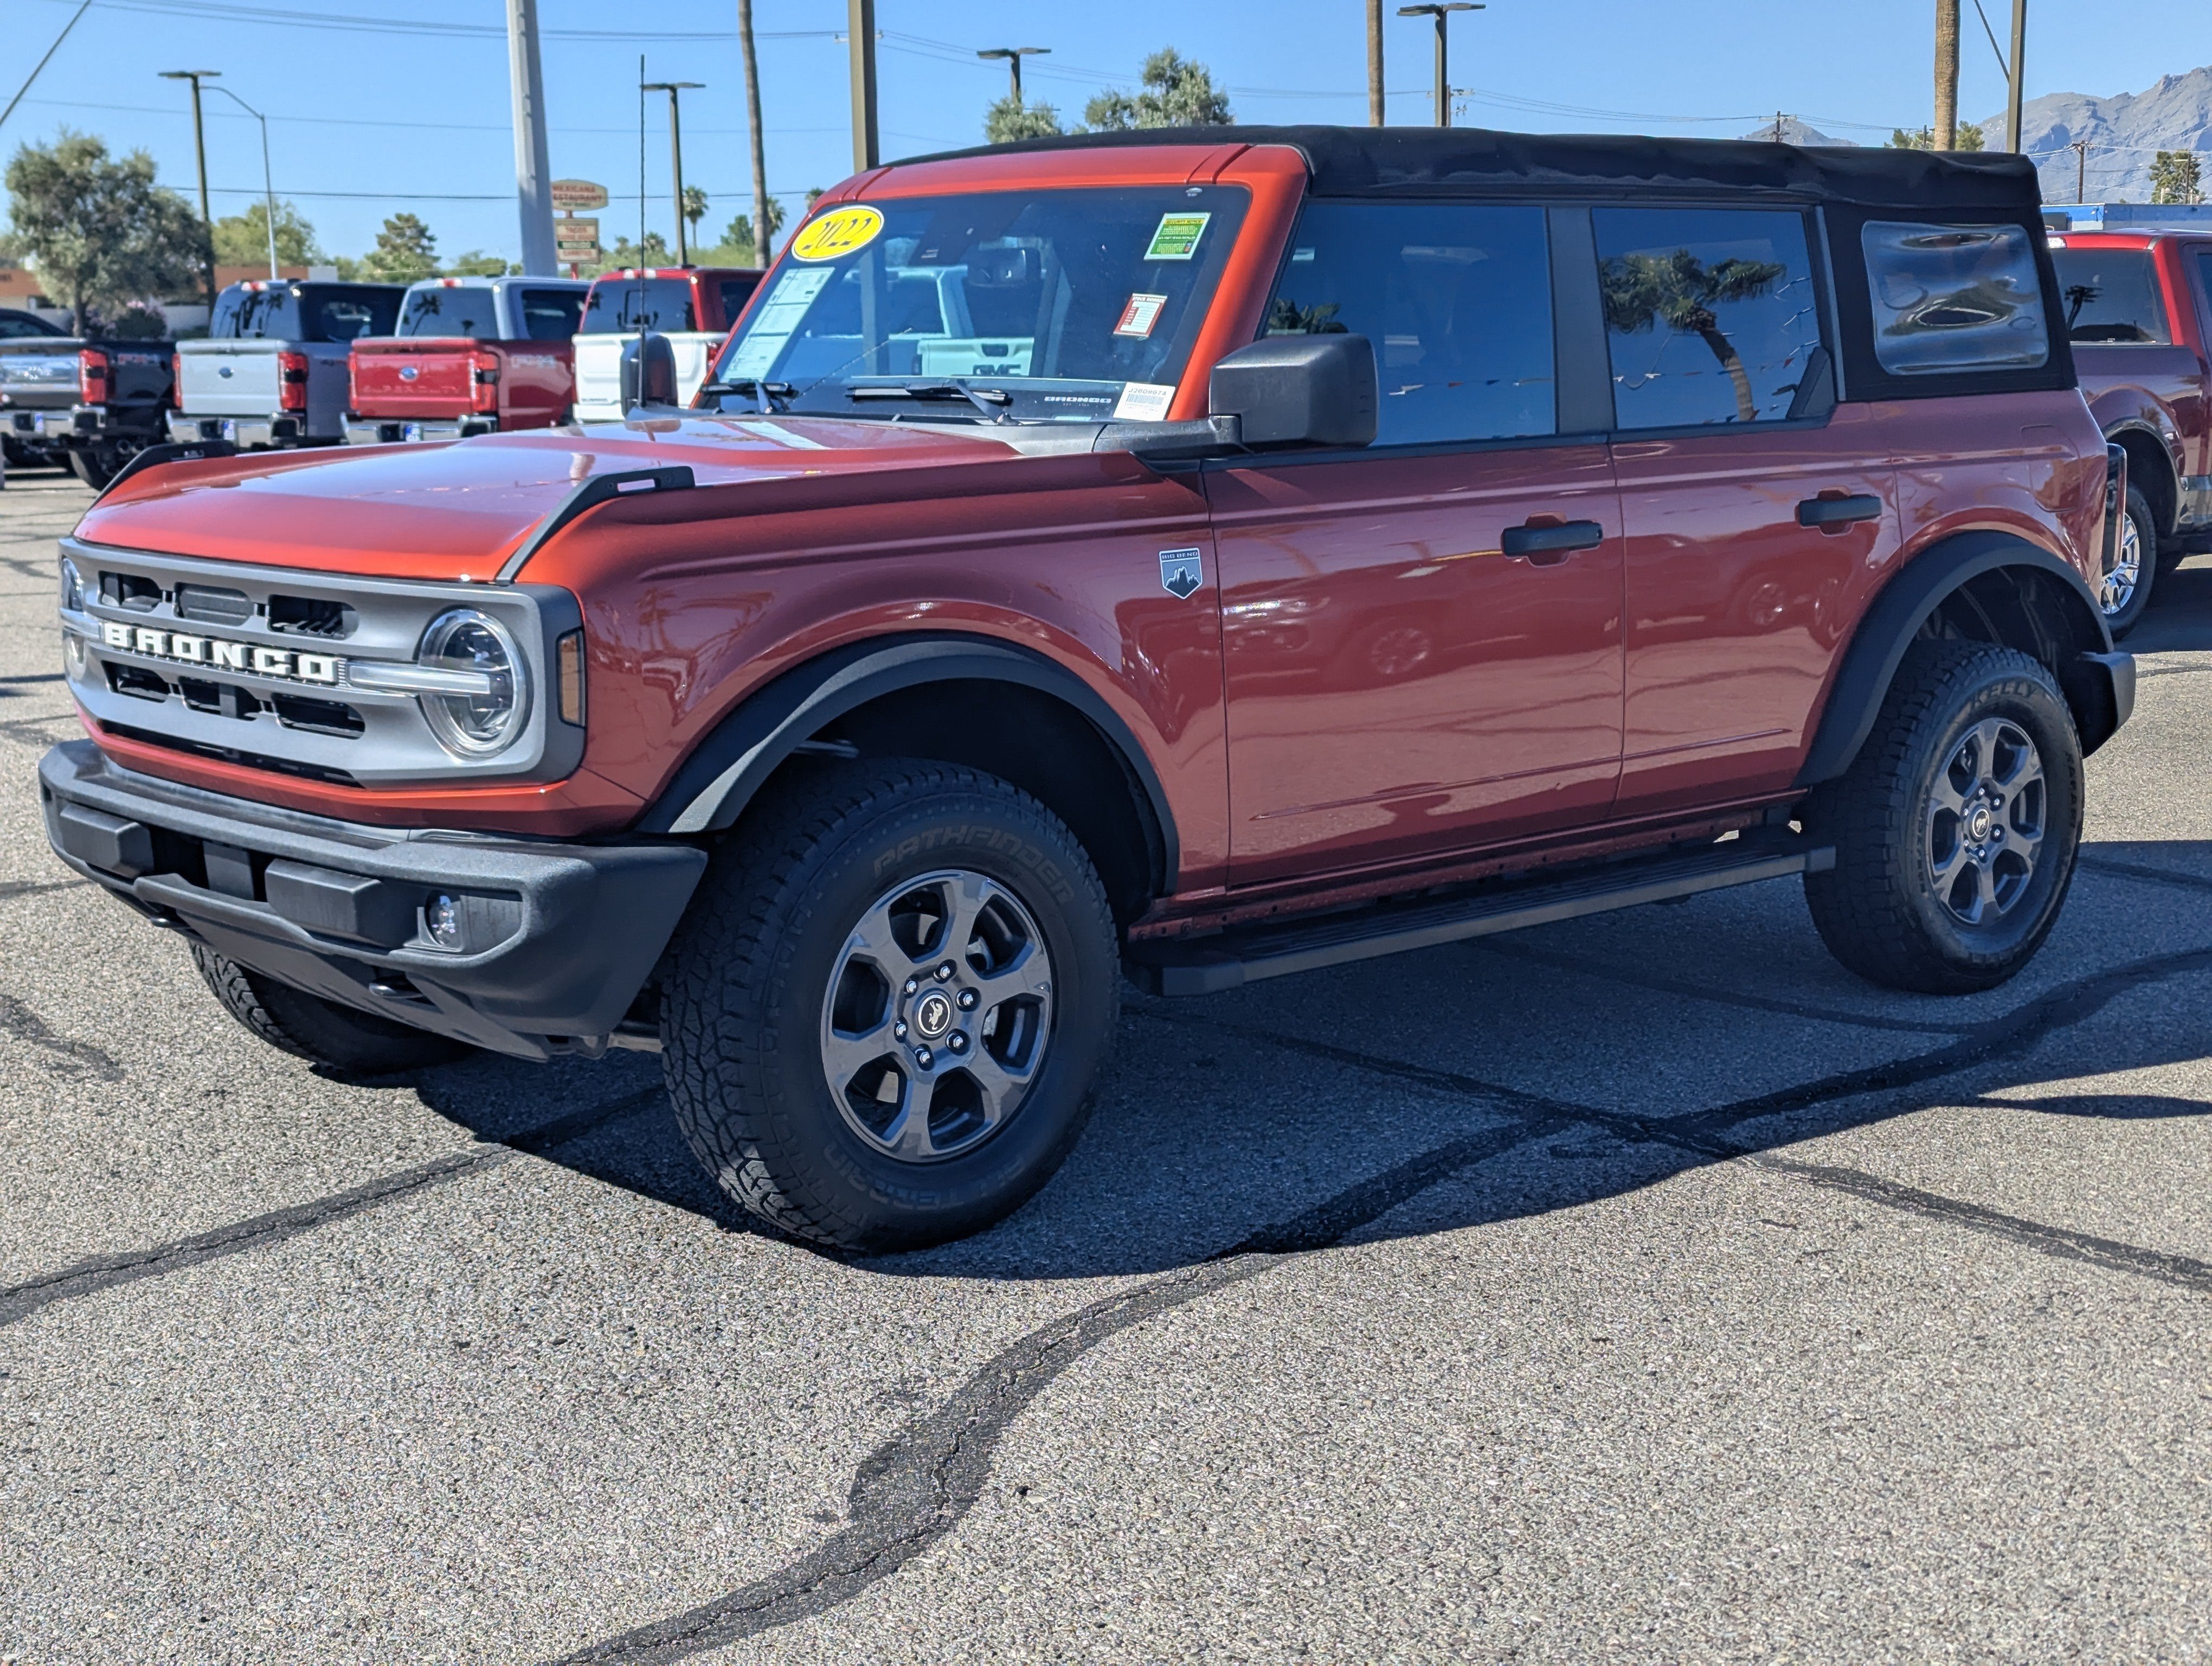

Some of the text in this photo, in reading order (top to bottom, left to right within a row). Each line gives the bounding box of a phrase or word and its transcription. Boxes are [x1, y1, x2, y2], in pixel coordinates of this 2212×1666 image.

[801, 217, 872, 251] 2022
[105, 620, 338, 683] BRONCO
[873, 824, 1075, 905] PATHFINDER
[822, 1141, 964, 1211] TERRAIN
